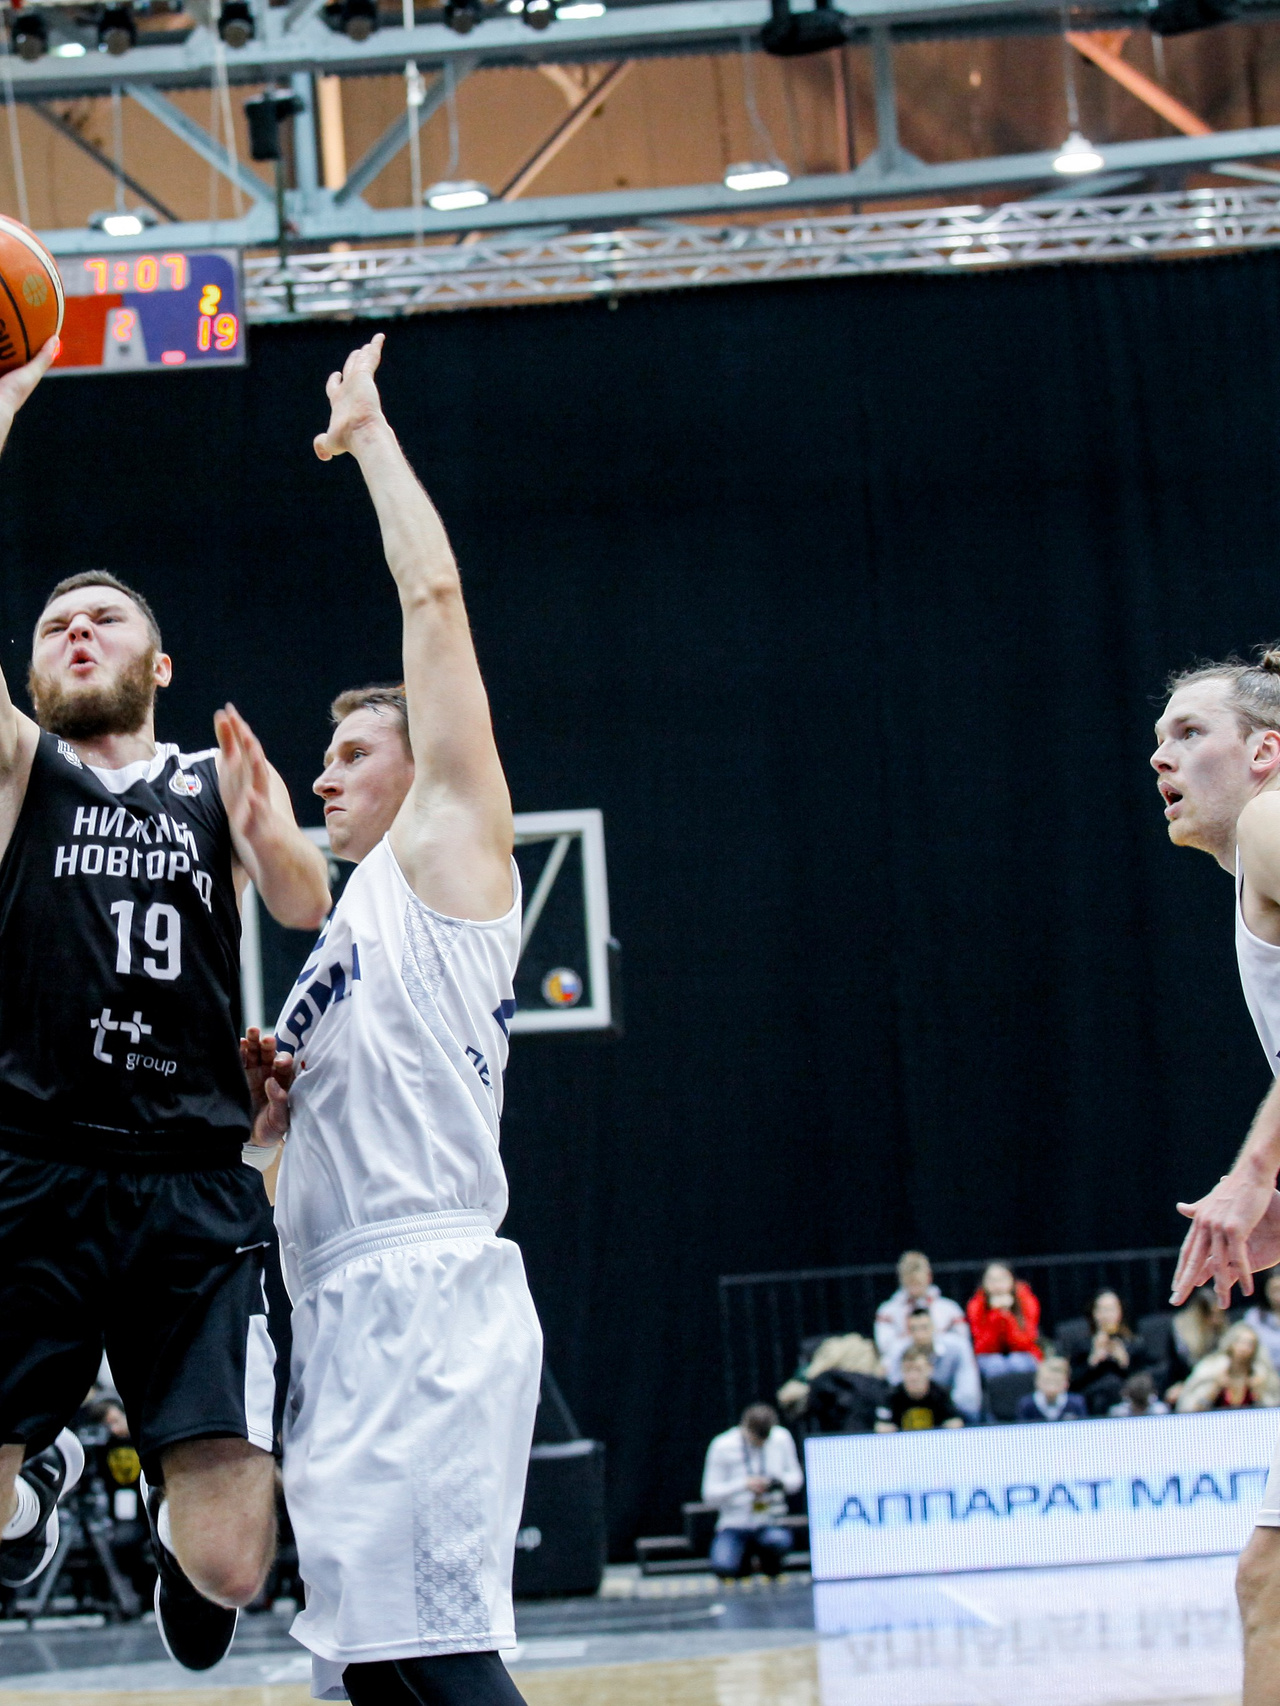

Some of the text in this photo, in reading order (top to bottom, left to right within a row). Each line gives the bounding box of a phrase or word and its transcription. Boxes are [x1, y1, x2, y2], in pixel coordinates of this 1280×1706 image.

[84, 253, 187, 294] 7:07
[197, 312, 239, 352] 19
[54, 844, 213, 914] НОВГОРД
[110, 900, 183, 981] 19
[126, 1052, 178, 1077] group
[833, 1467, 1270, 1528] АППАРАТ МАГ
